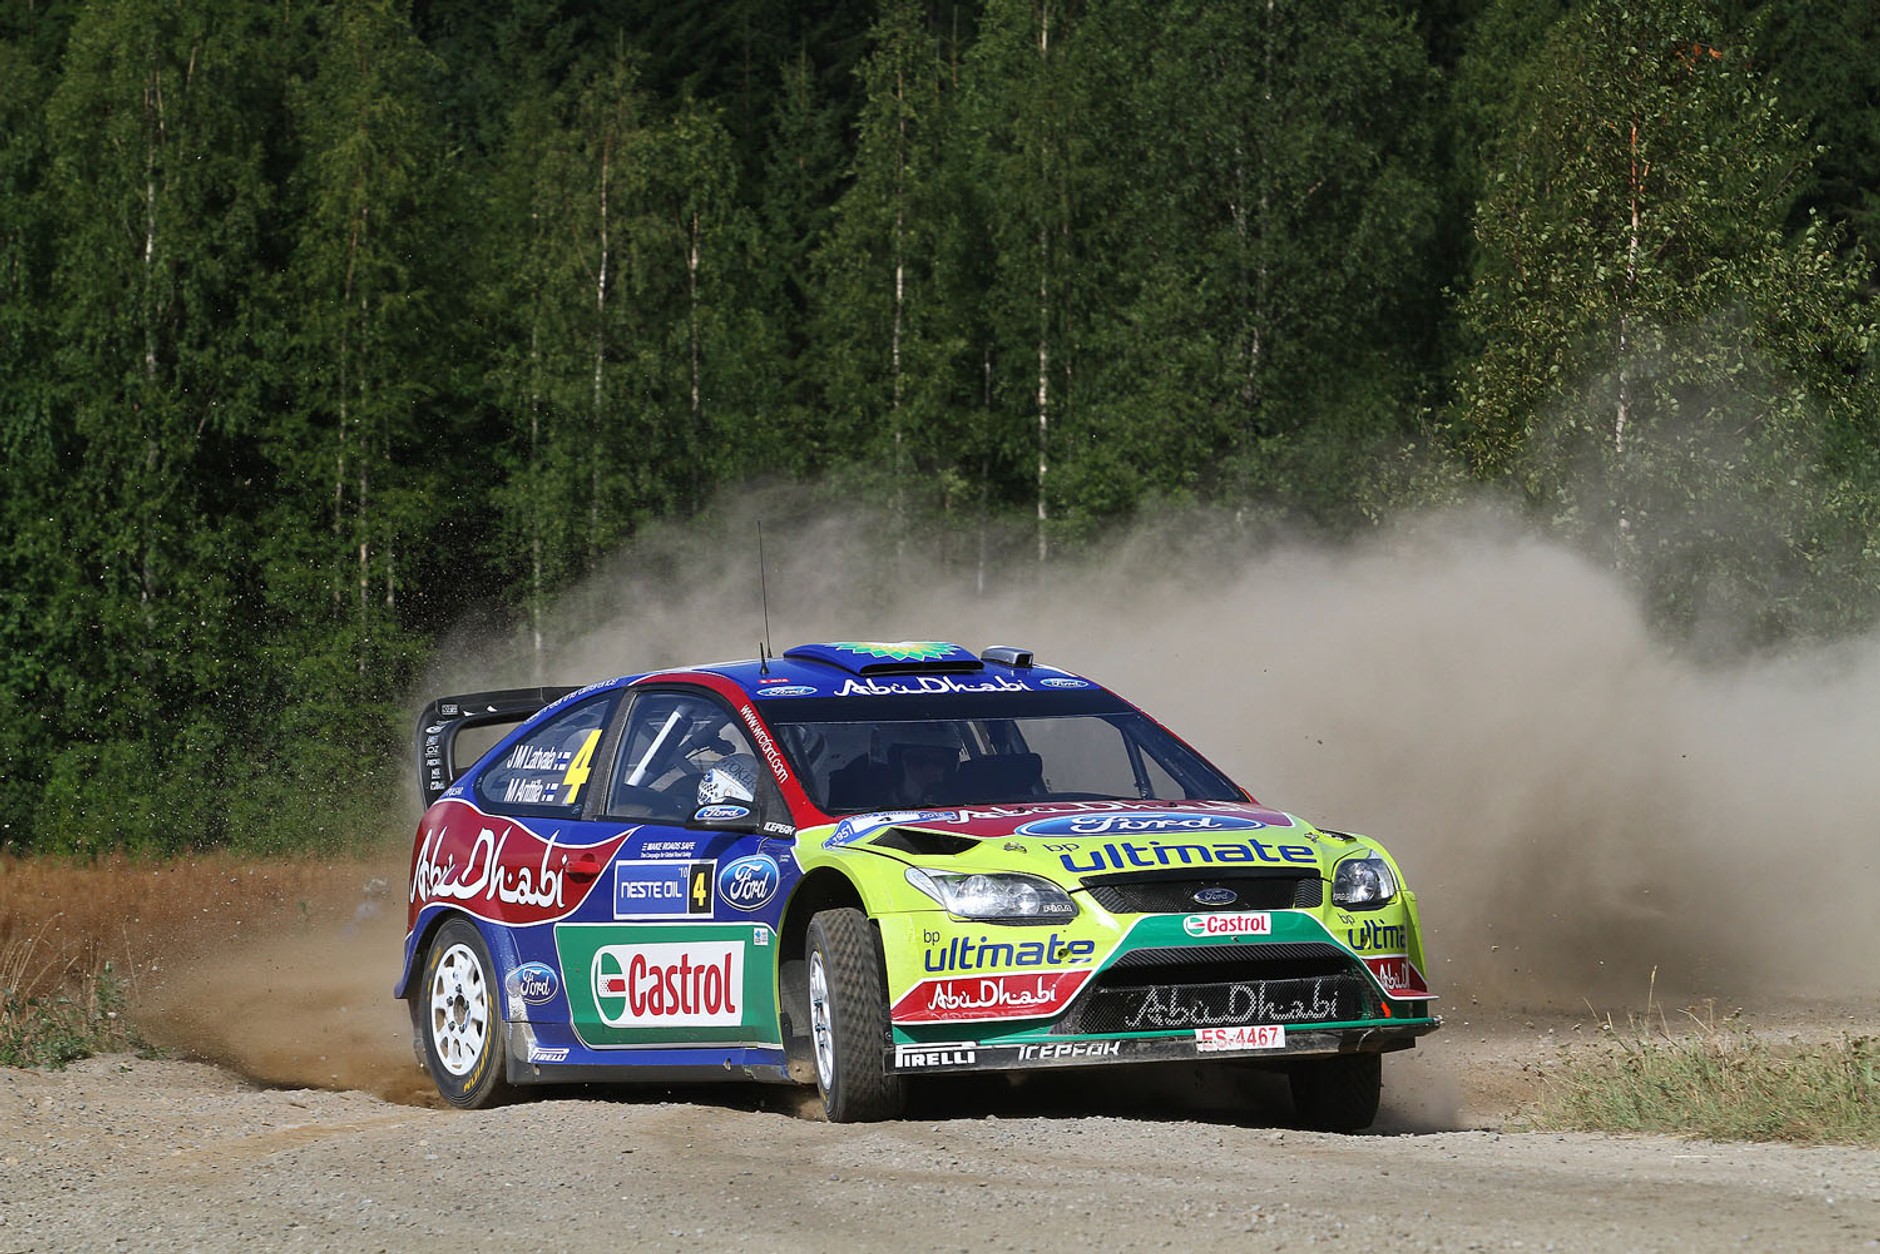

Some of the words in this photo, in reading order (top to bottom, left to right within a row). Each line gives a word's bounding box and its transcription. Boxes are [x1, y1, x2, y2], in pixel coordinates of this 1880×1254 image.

[740, 704, 788, 784] www.wrcford.com
[523, 746, 556, 770] Latvala
[562, 728, 603, 804] 4
[504, 778, 520, 802] M
[763, 822, 796, 835] ICEPEAK
[1071, 814, 1224, 833] Ford
[1043, 843, 1081, 853] bp
[1059, 838, 1318, 873] ultimate
[410, 826, 459, 903] Abu
[461, 825, 568, 908] Dhabi
[621, 882, 663, 899] NESTE
[664, 881, 683, 898] OIL
[693, 872, 707, 907] 4
[730, 864, 770, 900] Ford
[1204, 890, 1229, 900] Ford
[1207, 915, 1267, 933] Castrol
[1337, 913, 1355, 926] bp
[923, 929, 940, 945] bp
[924, 934, 1096, 972] ultimate
[519, 968, 551, 996] Ford
[629, 952, 736, 1017] Castrol
[927, 981, 977, 1010] Abu
[979, 976, 1057, 1008] Dhabi
[1125, 985, 1212, 1030] Abu
[1228, 979, 1339, 1025] Dhabi
[531, 1048, 570, 1062] PIRELLI
[895, 1041, 976, 1068] PIRELLI
